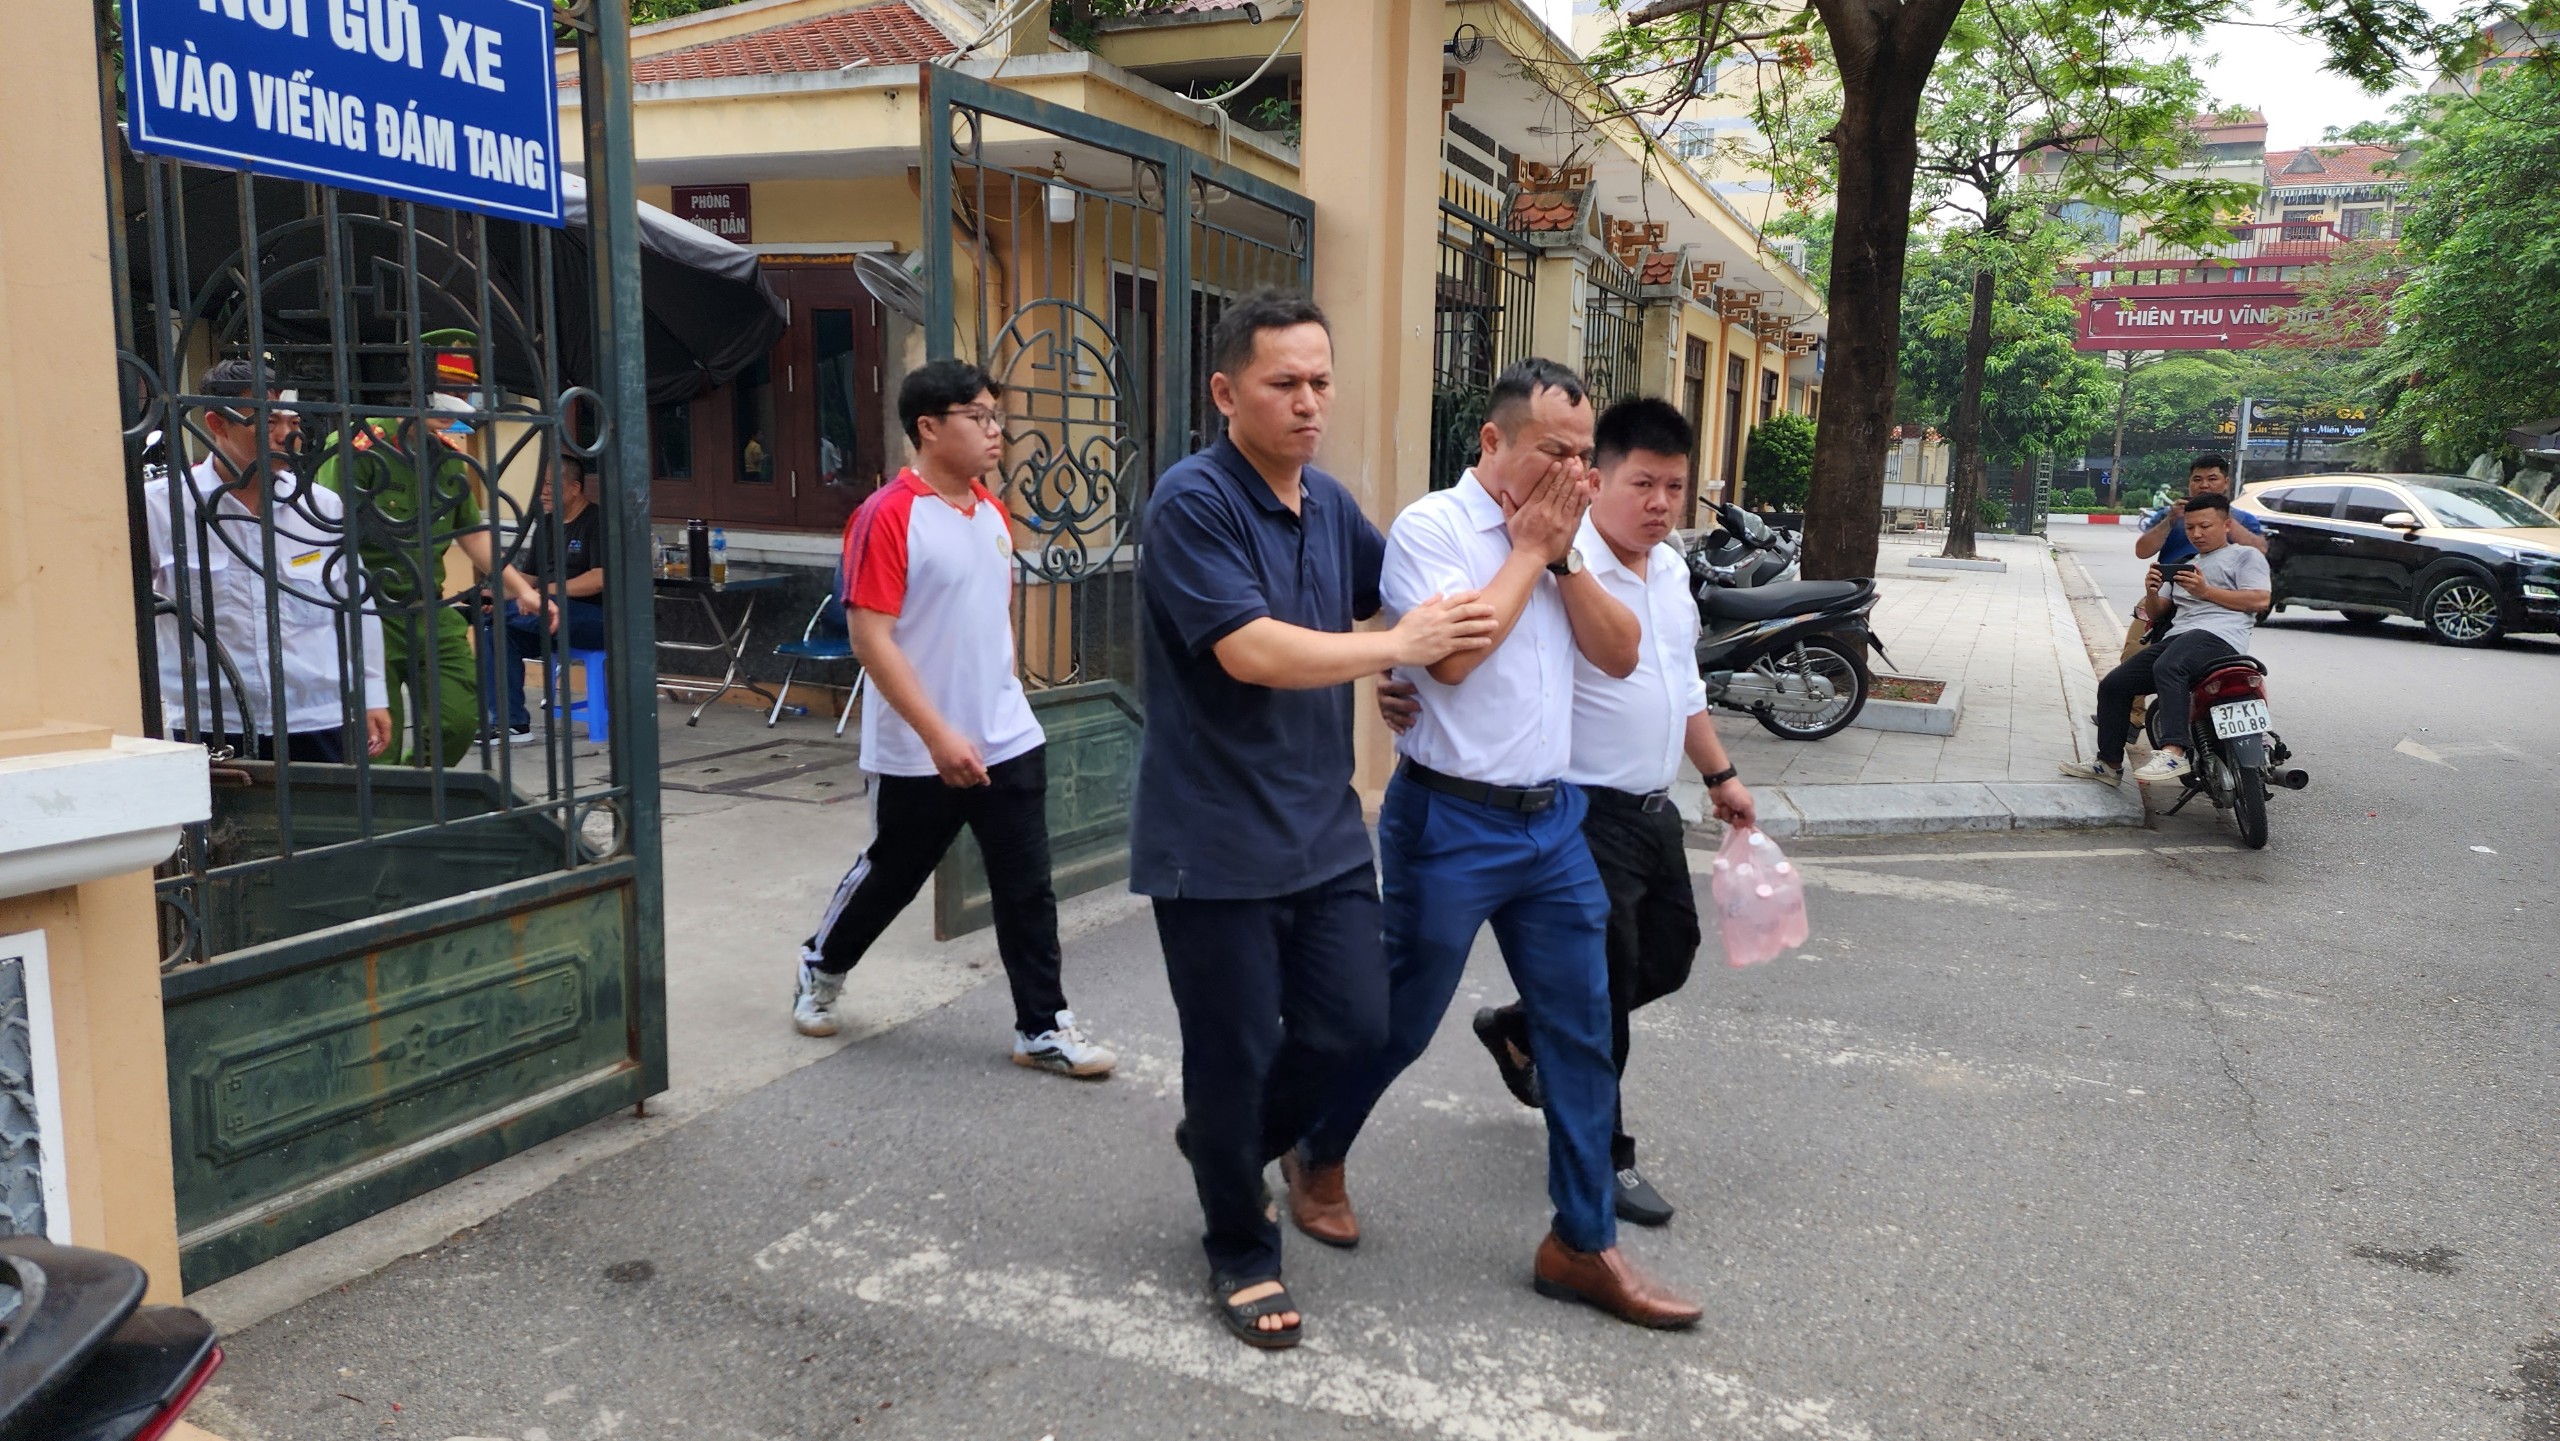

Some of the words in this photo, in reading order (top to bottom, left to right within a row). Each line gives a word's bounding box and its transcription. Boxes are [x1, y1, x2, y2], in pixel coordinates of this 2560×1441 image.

[438, 13, 506, 93] XE
[150, 40, 239, 123] VÀO
[248, 69, 367, 152] VIẾNG
[375, 100, 457, 172] ĐÁM
[463, 125, 547, 191] TANG
[691, 191, 730, 209] PHÒNG
[721, 211, 746, 234] DẪN
[2115, 306, 2175, 327] THIÊN
[2180, 308, 2223, 325] THU
[2342, 424, 2366, 437] Ngan
[2219, 702, 2258, 721] 37-K1
[2219, 716, 2267, 736] 500.88
